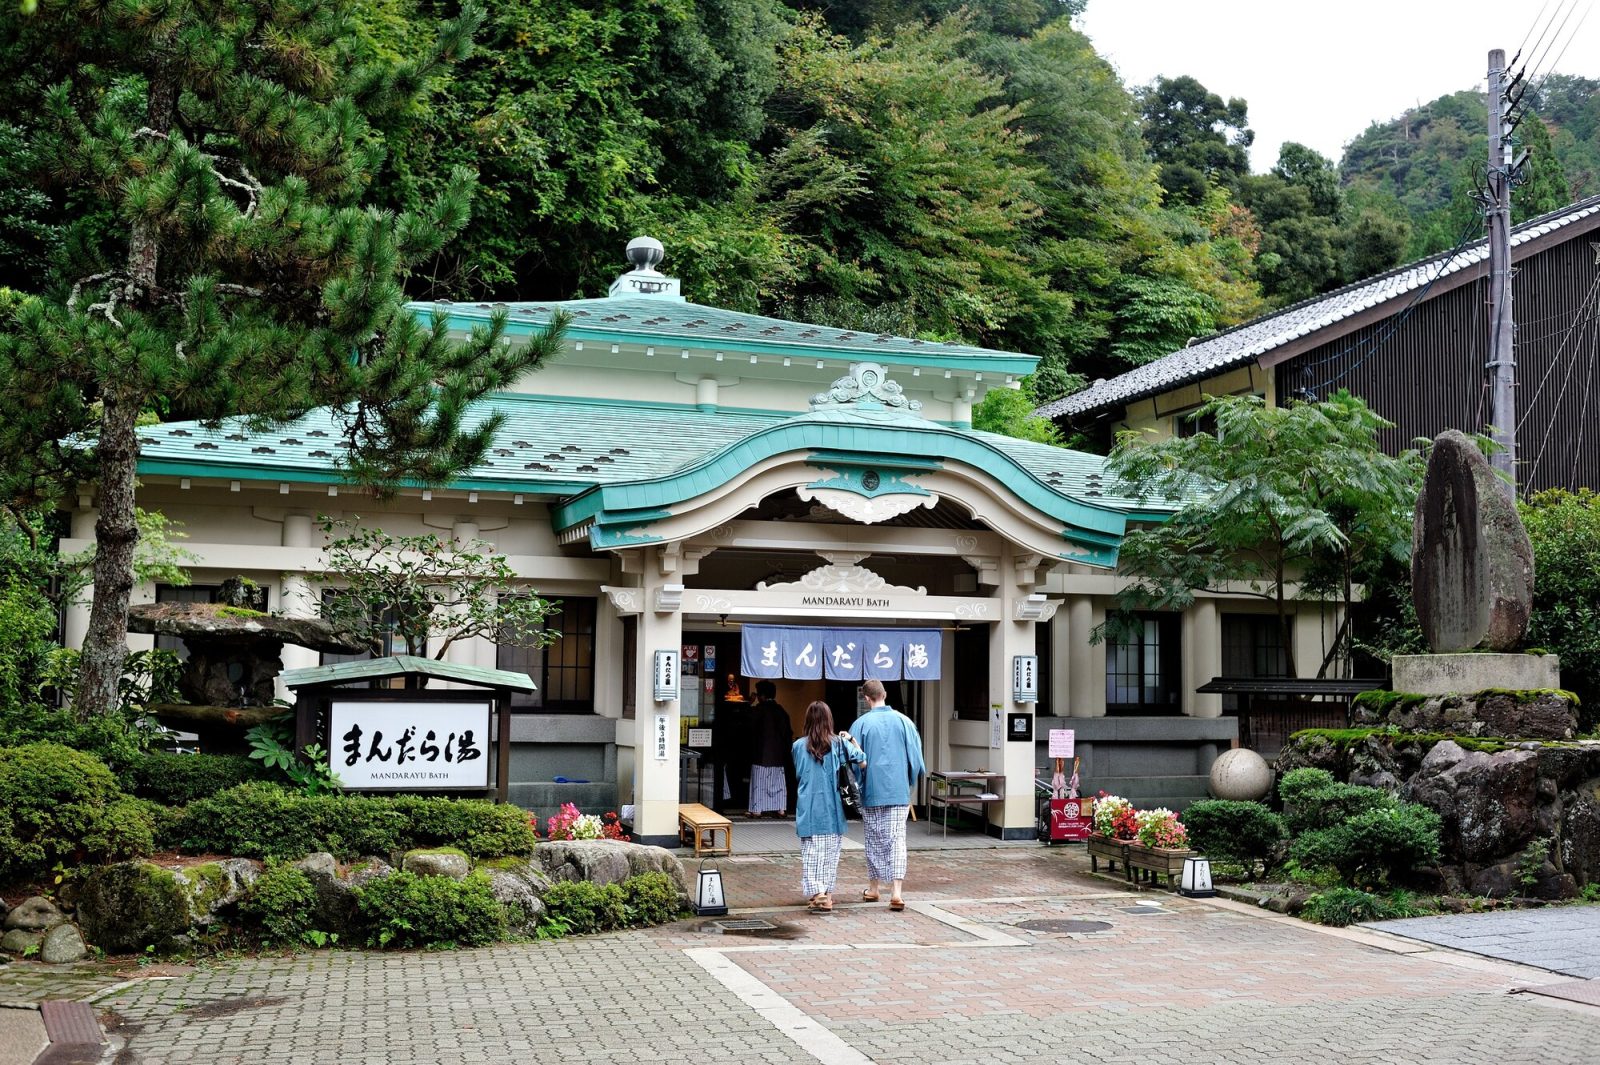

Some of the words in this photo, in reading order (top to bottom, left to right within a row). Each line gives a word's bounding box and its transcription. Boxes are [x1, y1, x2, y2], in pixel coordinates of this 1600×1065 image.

[802, 596, 864, 606] MANDARAYU
[866, 598, 890, 607] BATH
[760, 640, 929, 669] まんだら湯
[342, 723, 482, 767] まんだら湯
[370, 772, 428, 780] MANDARAYU
[428, 772, 449, 780] BATH
